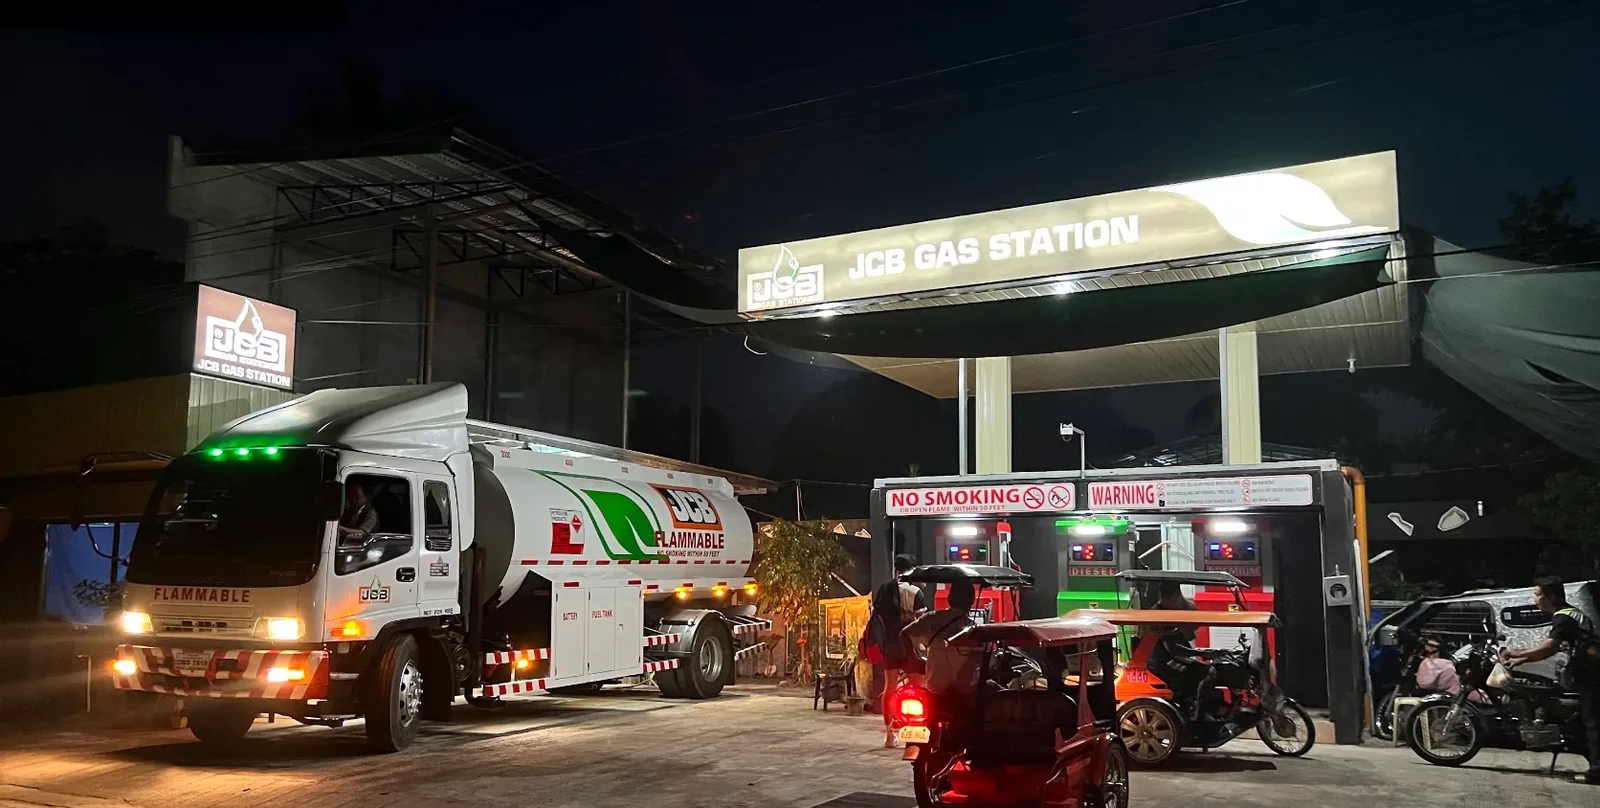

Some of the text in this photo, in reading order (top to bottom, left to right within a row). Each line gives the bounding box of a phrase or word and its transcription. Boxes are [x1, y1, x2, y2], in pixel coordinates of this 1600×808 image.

[848, 214, 1140, 280] JCB GAS STATION
[753, 272, 817, 302] JCB
[213, 327, 280, 363] JCB
[197, 359, 220, 372] JCB
[221, 363, 245, 377] GAS
[246, 368, 291, 387] STATION
[892, 489, 1020, 507] NO SMOKING
[1091, 484, 1154, 505] WARNING
[666, 489, 717, 523] JCB
[654, 530, 725, 549] FLAMMABLE
[1072, 567, 1115, 576] DIESEL
[154, 587, 250, 603] FLAMMABLE
[361, 589, 388, 600] JCB
[1126, 672, 1148, 683] 0440
